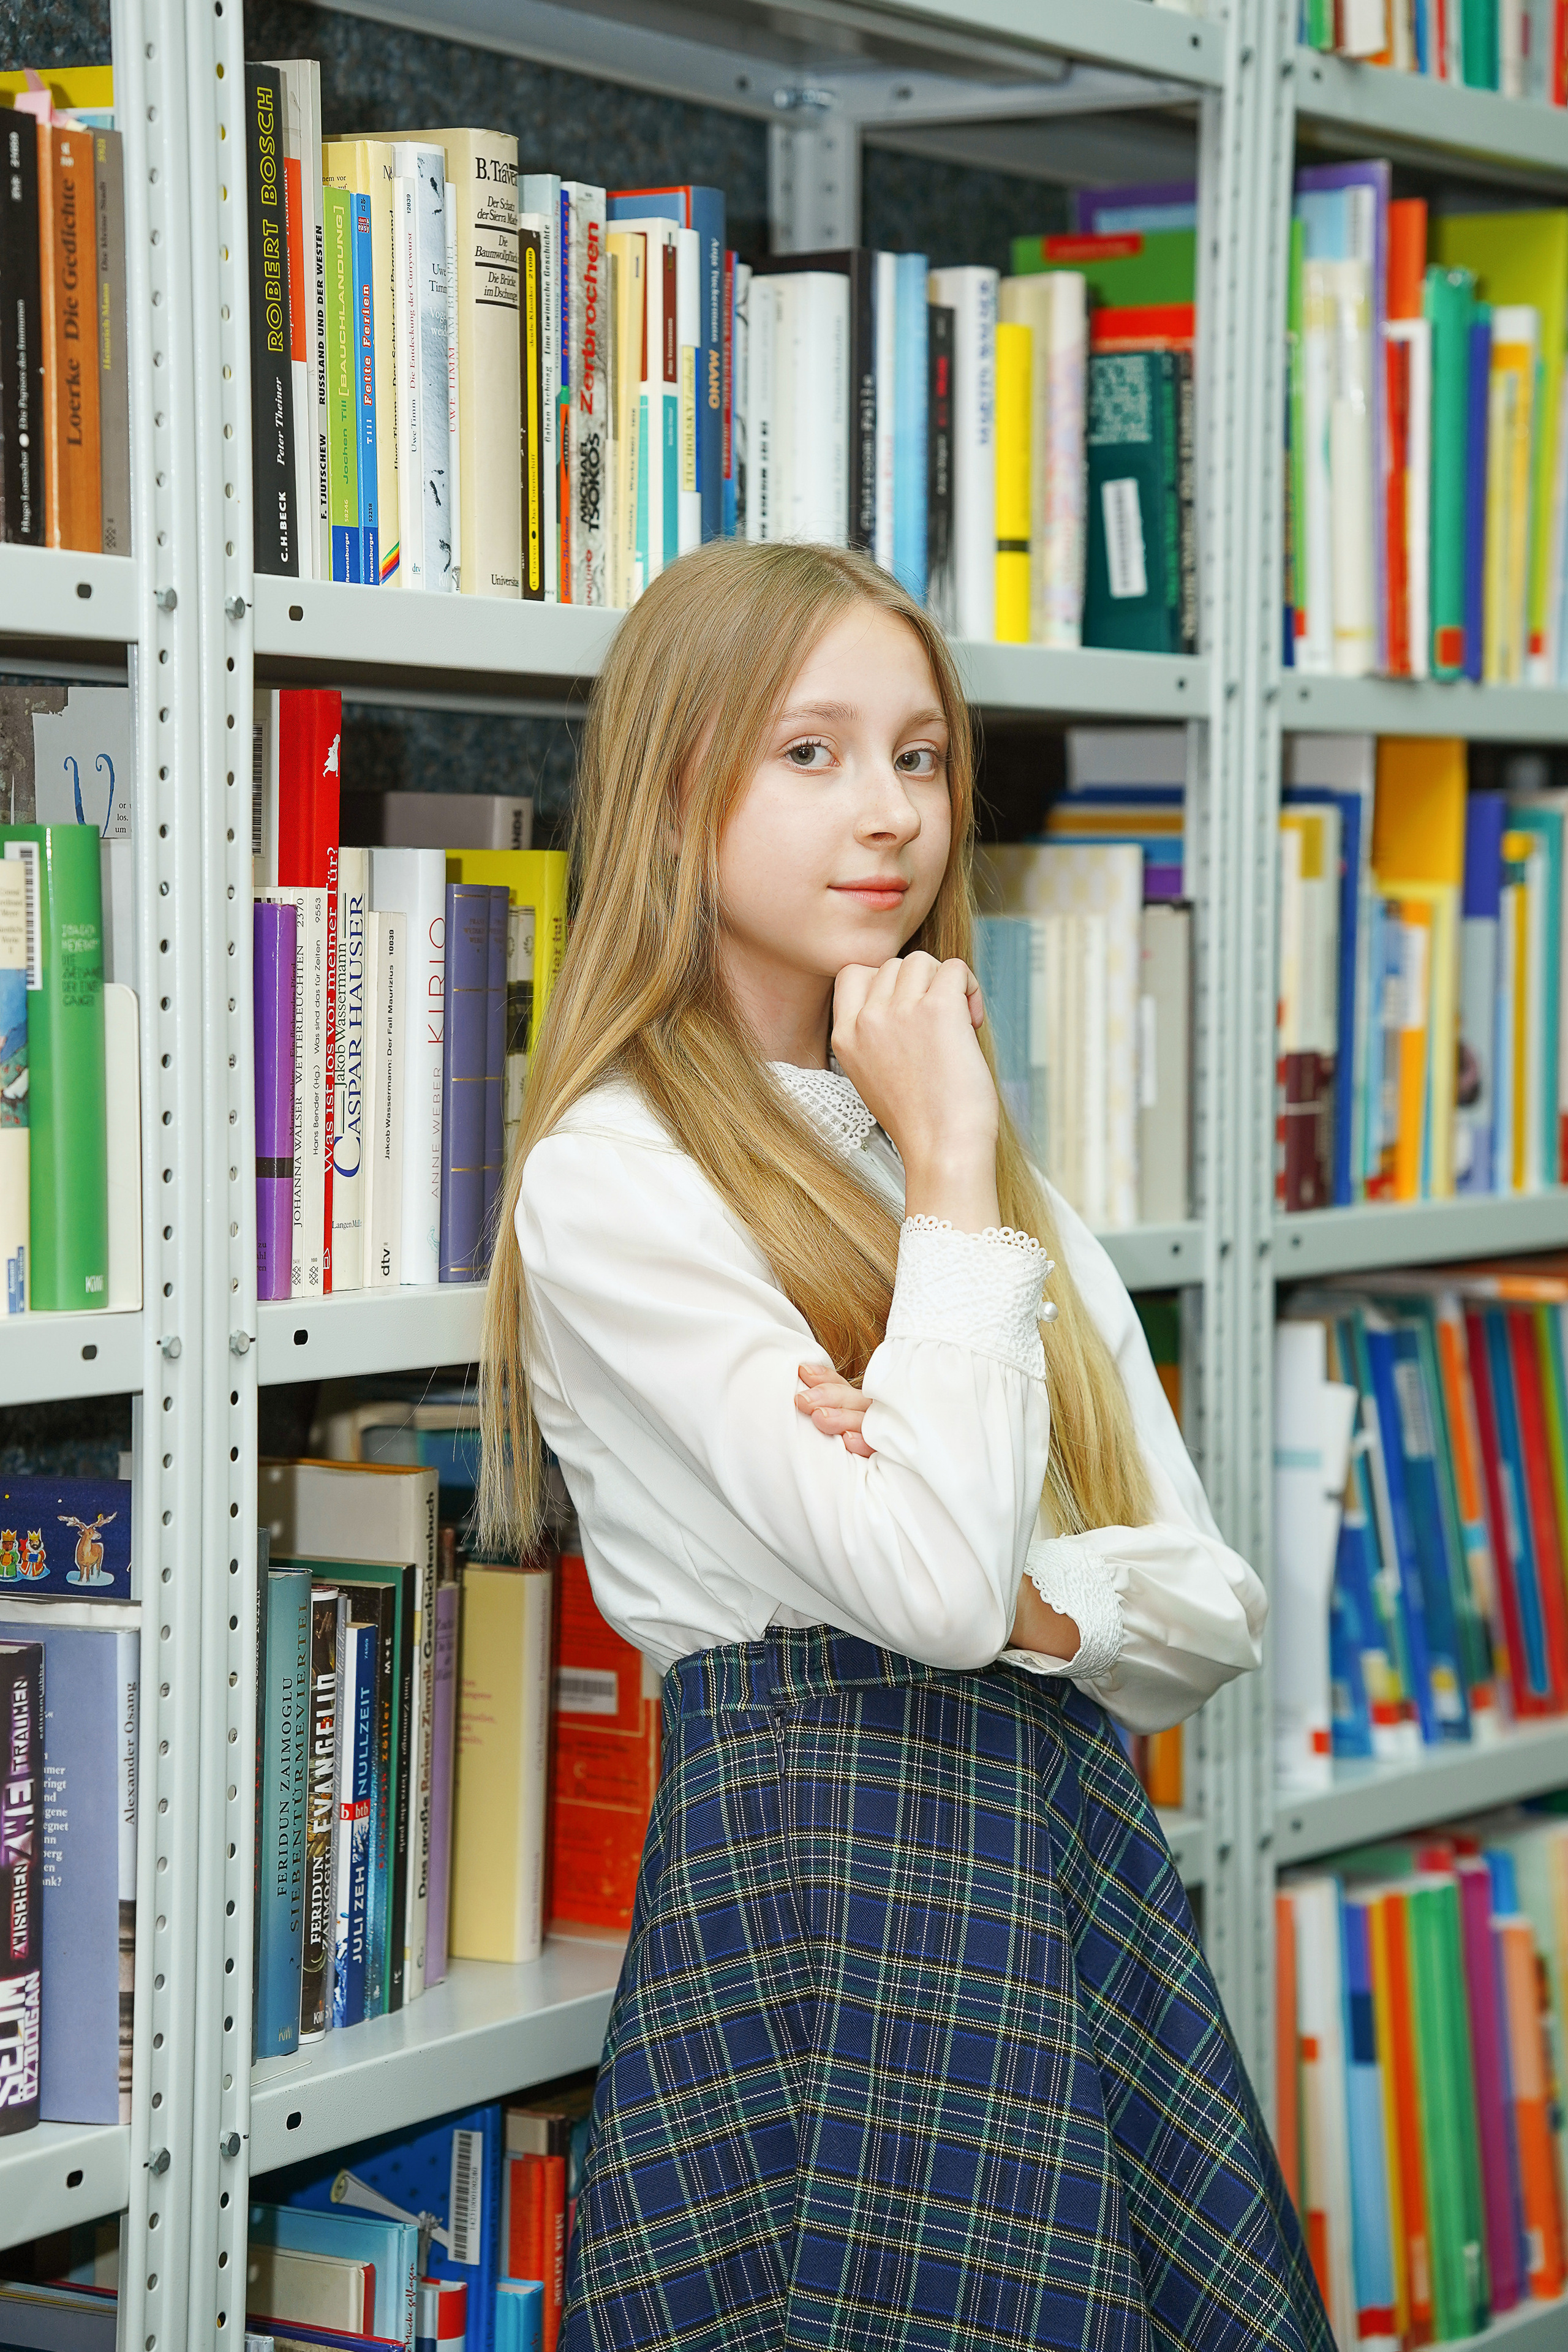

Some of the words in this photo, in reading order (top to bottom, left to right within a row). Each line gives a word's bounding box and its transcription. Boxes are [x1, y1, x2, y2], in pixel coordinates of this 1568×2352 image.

[257, 86, 277, 206] BOSCH
[475, 157, 490, 181] B.
[358, 224, 369, 233] easy
[477, 209, 489, 219] der
[489, 209, 507, 223] Sierra
[488, 195, 499, 208] Der
[60, 178, 77, 290] Gedichte
[406, 232, 415, 288] Currywurst
[499, 235, 508, 247] Die
[543, 224, 551, 277] Geschichte
[262, 218, 284, 352] ROBERT
[334, 205, 350, 396] [BAUCHLANDUNG]
[432, 263, 447, 276] Uwe
[484, 285, 493, 296] im
[488, 271, 499, 283] Die
[62, 297, 80, 341] Die
[316, 309, 325, 337] UND
[361, 284, 371, 347] Ferien
[580, 222, 600, 415] Zerbrochen
[63, 358, 83, 447] Loerke
[274, 377, 284, 428] Theiner
[317, 341, 326, 405] RUSSLAND
[363, 355, 373, 407] Fette
[708, 349, 721, 410] MANO
[276, 431, 286, 466] Peter
[318, 433, 327, 505] TJUTSCHEW
[579, 442, 589, 524] MICHAEL
[588, 433, 600, 532] TSOKOS
[277, 491, 289, 562] C.H.BECK
[320, 510, 327, 519] F.
[117, 813, 129, 821] los.
[326, 846, 338, 895] Tür?
[328, 906, 336, 991] meiner
[428, 917, 445, 1043] KIRIO
[295, 944, 304, 1085] WETTERLEUCHTEN
[335, 943, 347, 1044] Wassermann
[325, 1041, 335, 1077] los
[333, 1036, 362, 1178] CASPAR
[349, 892, 363, 1029] HAUSER
[336, 1044, 347, 1088] Jakob
[432, 1067, 441, 1135] WEBER
[325, 1117, 334, 1174] Was
[431, 1144, 440, 1199] ANNE
[293, 1155, 303, 1227] JOHANNA
[381, 1248, 390, 1276] dtv
[423, 1490, 435, 1659] Geschichtenbuch
[124, 1681, 137, 1734] Osang
[422, 1663, 432, 1728] Zimnik
[280, 1677, 293, 1792] ZAIMOGLU
[290, 1597, 308, 1933] SIEBENTÜRMEVIERTEL
[313, 1672, 336, 1834] EVANGELIO
[358, 1687, 371, 1796] NULLZEIT
[421, 1730, 431, 1792] Reiner
[43, 1779, 67, 1792] ringt
[123, 1739, 135, 1825] Alexander
[277, 1800, 290, 1898] FERIDUN
[418, 1796, 429, 1863] große
[12, 1860, 28, 1957] ZWISCHEN
[310, 1855, 324, 1945] FERIDUN
[322, 1845, 332, 1951] ZAIMOGLU
[354, 1866, 365, 1912] ZEH
[418, 1865, 427, 1899] Das
[352, 1917, 364, 1964] JULI
[0, 1977, 26, 2108] SELIM
[405, 2263, 417, 2308] geflogen
